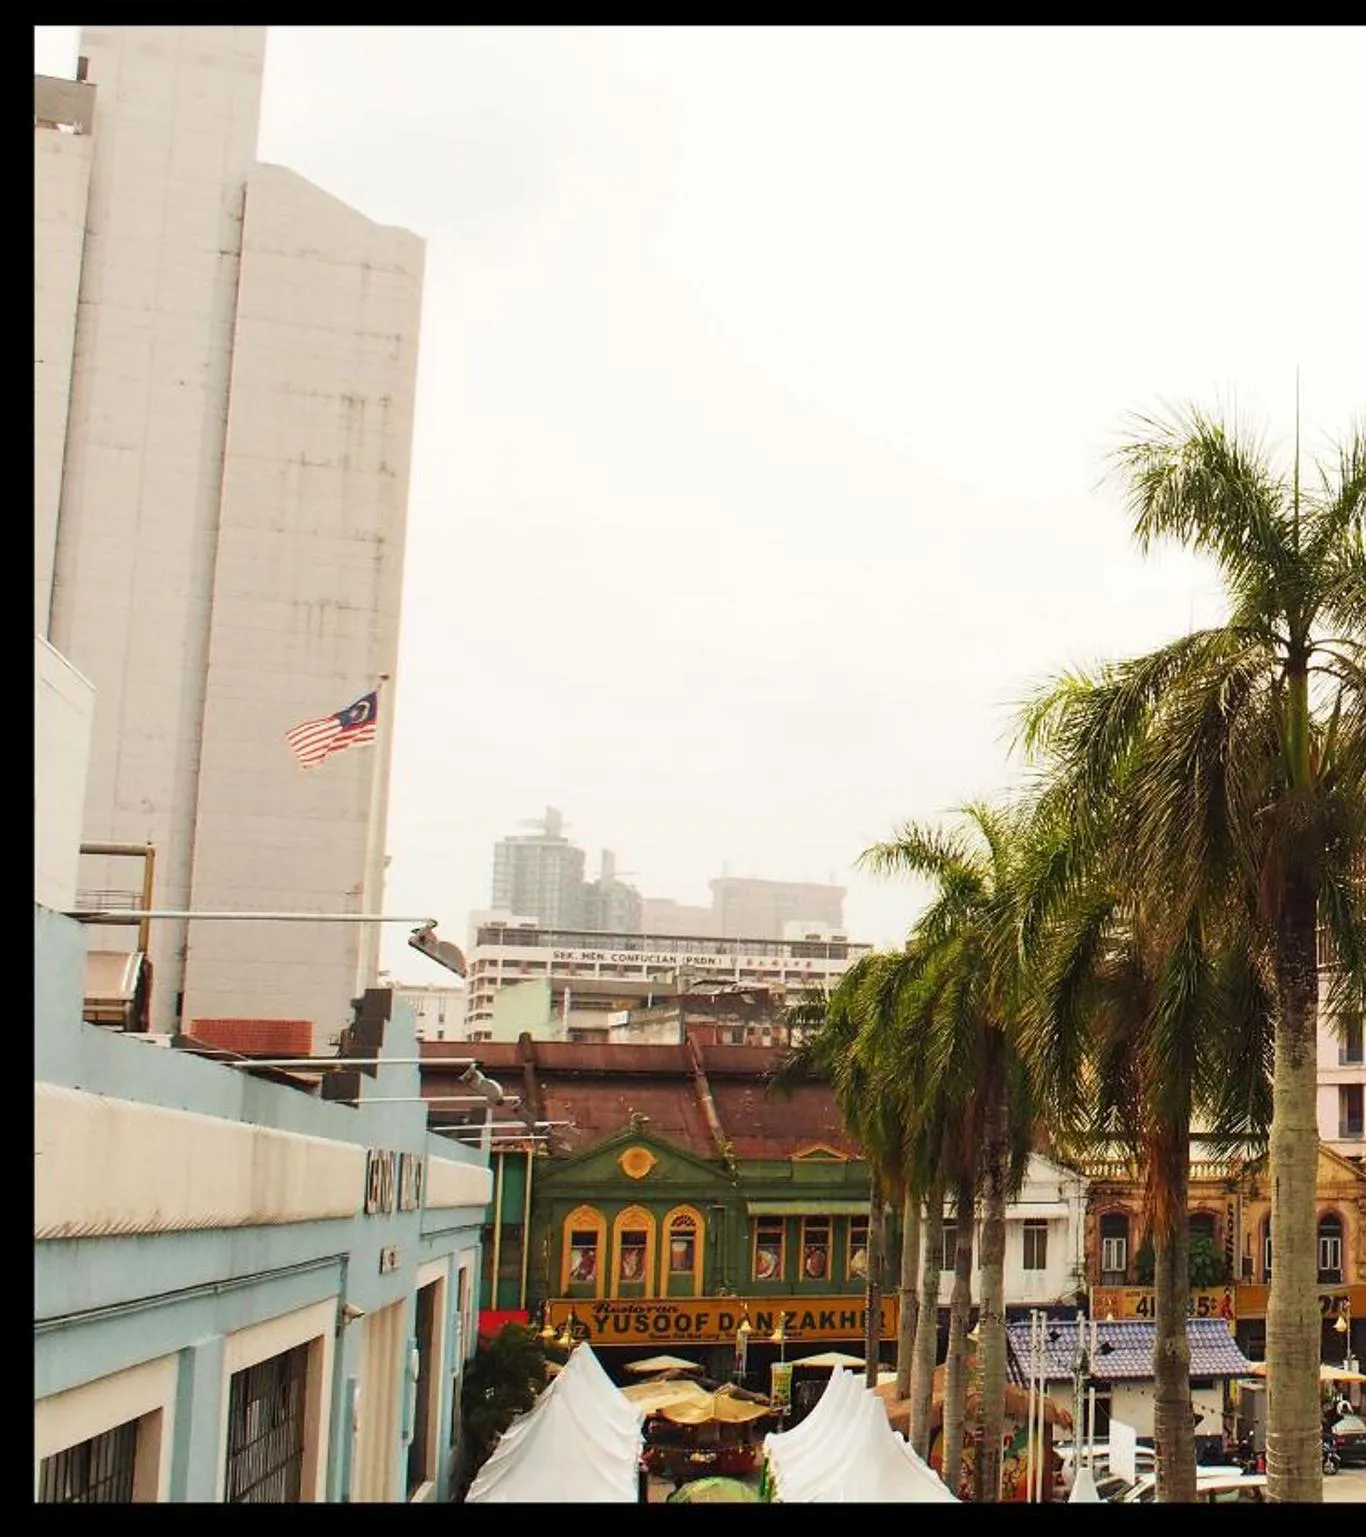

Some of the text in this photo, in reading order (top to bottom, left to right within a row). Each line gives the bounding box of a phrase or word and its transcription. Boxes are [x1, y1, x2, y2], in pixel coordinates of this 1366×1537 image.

[592, 1300, 677, 1314] Restoran
[592, 1311, 710, 1333] YUSOOF
[718, 1311, 773, 1330] DAN
